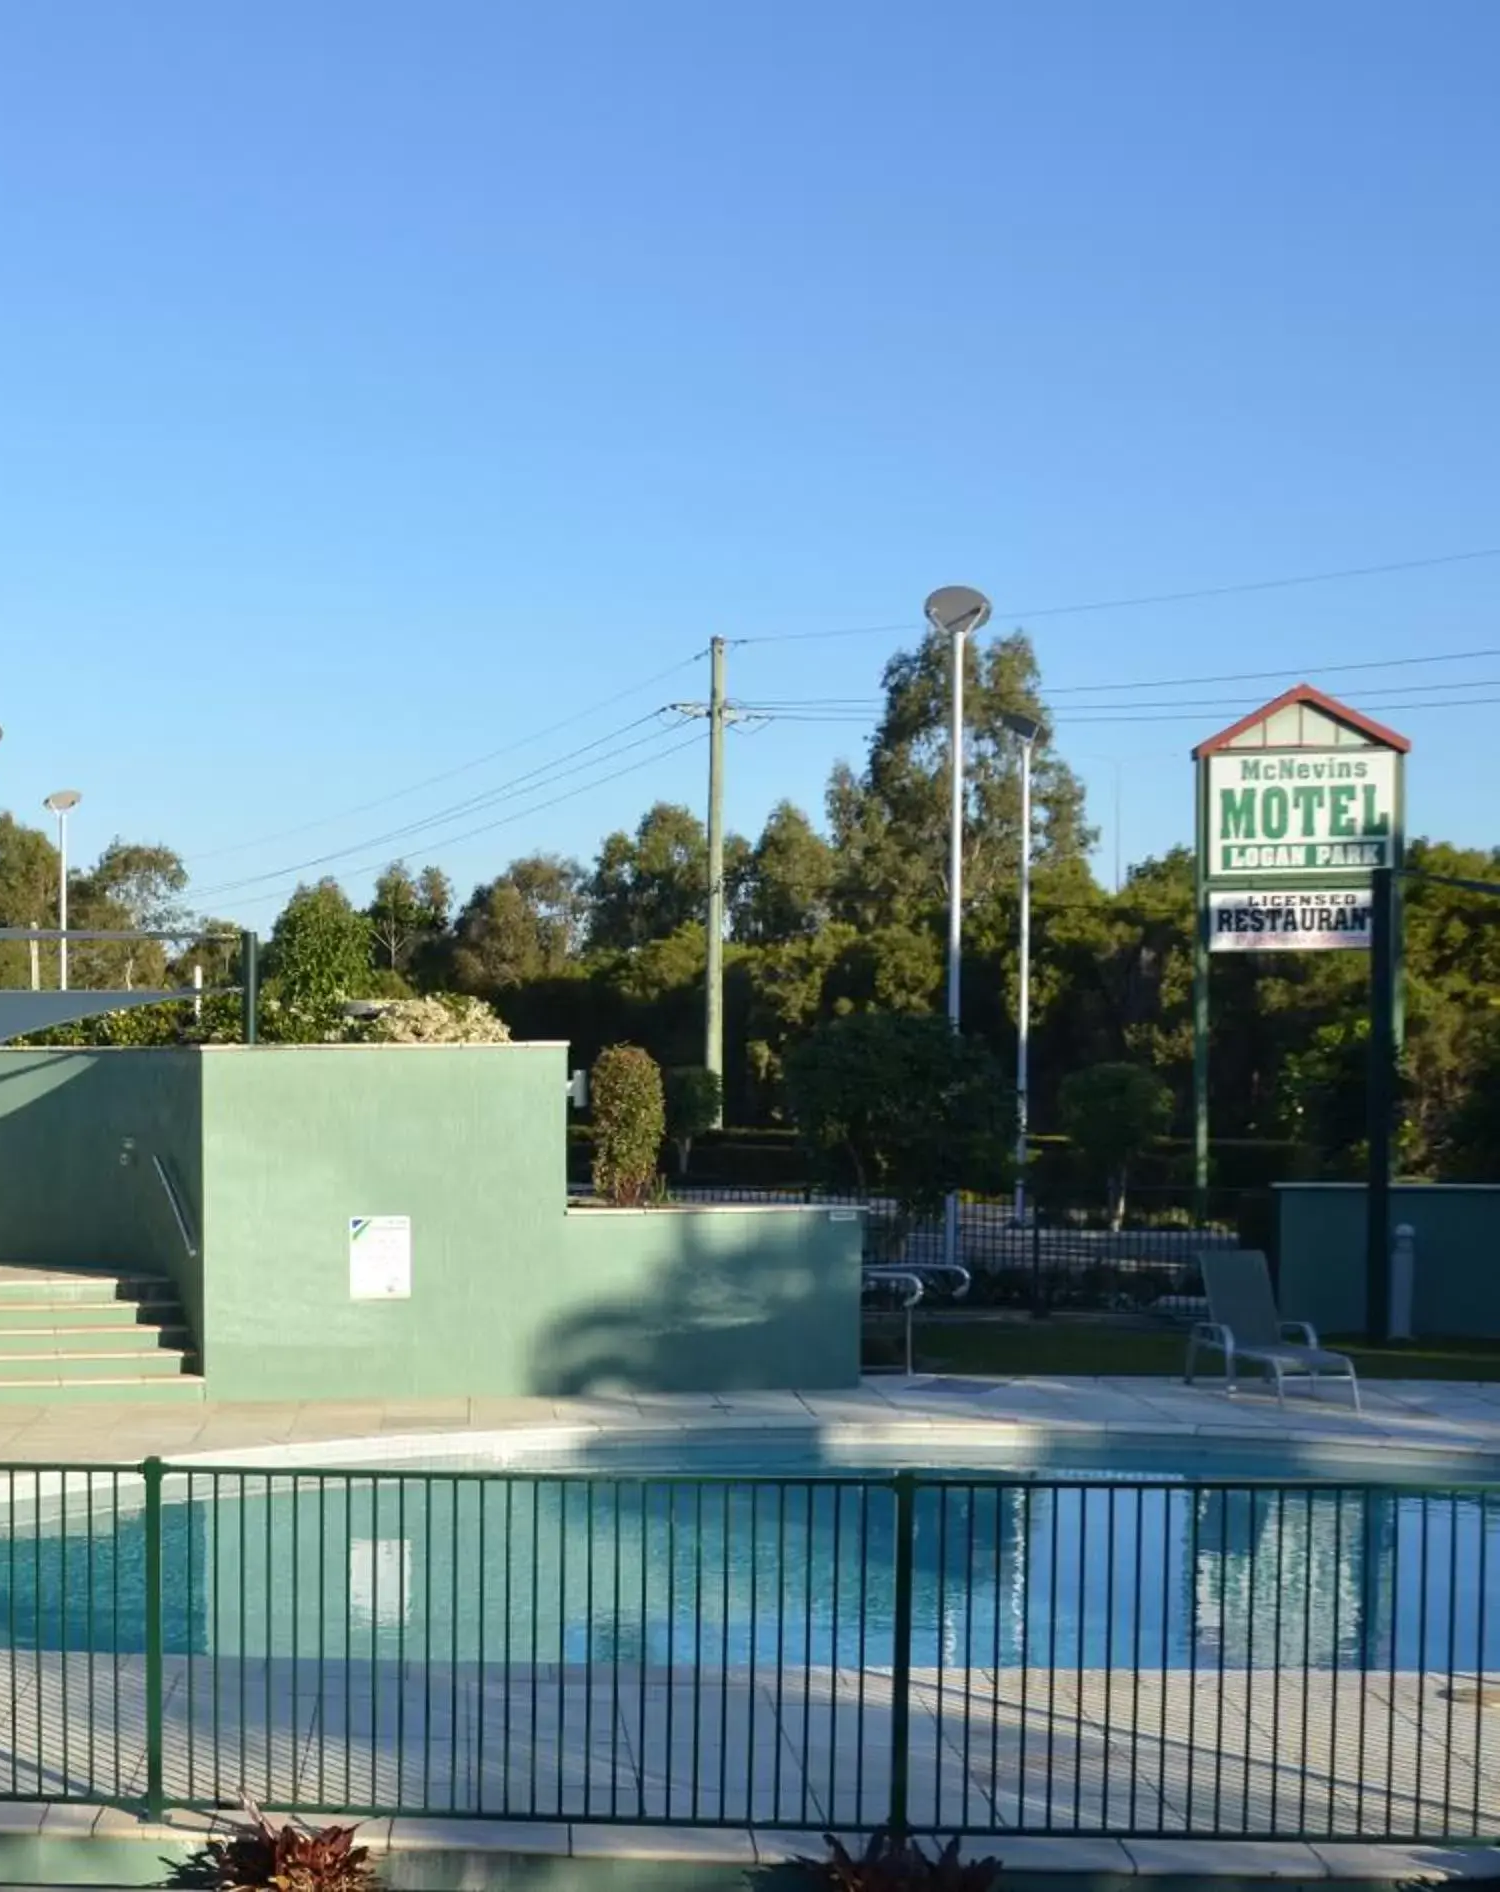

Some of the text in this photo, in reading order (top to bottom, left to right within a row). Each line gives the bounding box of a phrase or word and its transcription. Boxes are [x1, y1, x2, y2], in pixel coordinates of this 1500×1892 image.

[1241, 757, 1368, 781] McNevins
[1220, 784, 1389, 840] MOTEL
[1231, 843, 1380, 868] LOGAN PARK
[1248, 894, 1357, 908] LICENSED
